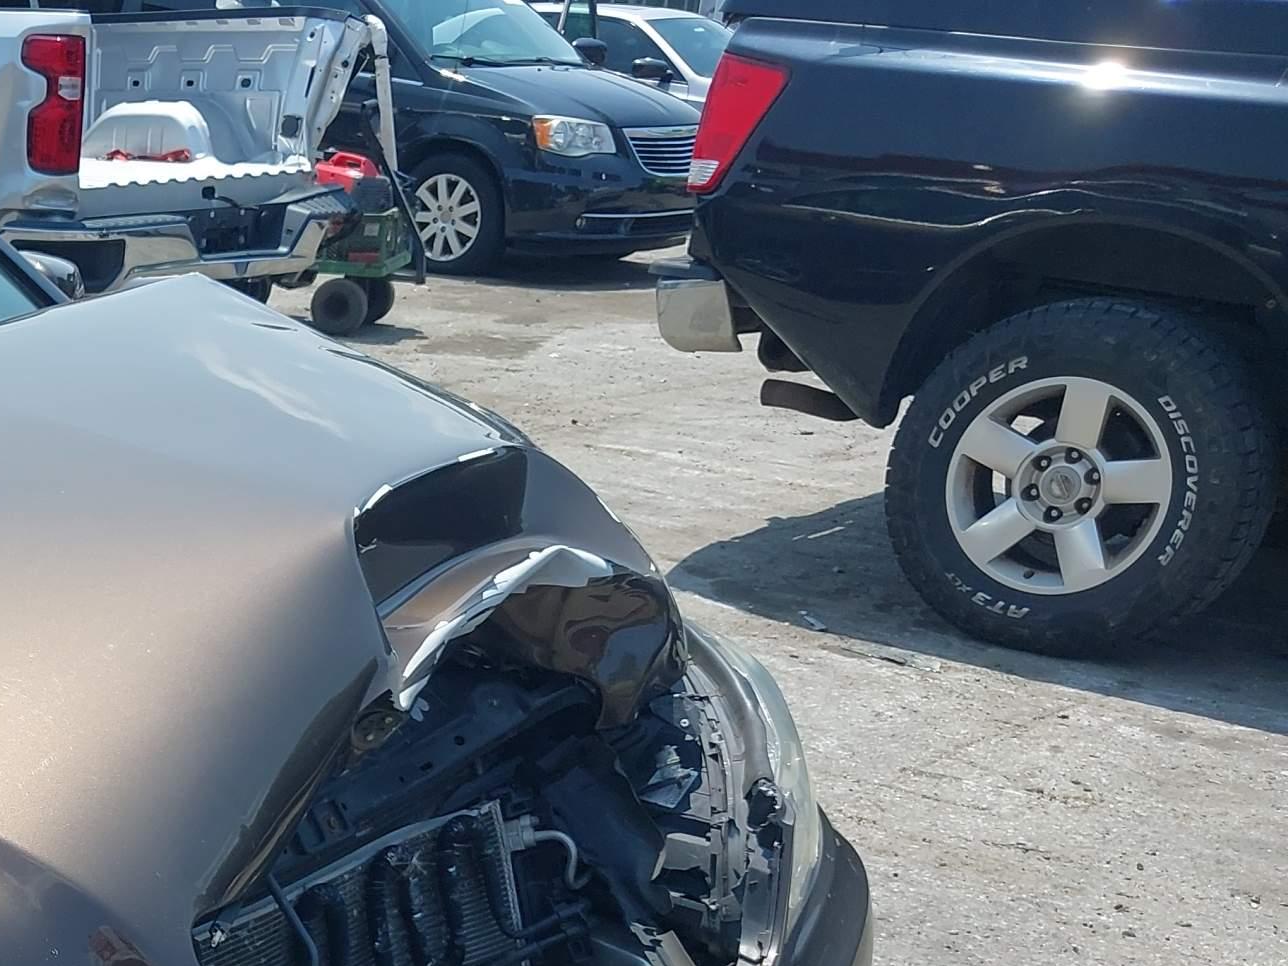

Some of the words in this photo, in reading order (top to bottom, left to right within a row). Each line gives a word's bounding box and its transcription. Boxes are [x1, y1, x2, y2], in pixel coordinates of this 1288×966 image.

[928, 356, 1028, 448] COOPER
[1157, 395, 1200, 566] DISCOVERER
[971, 592, 1031, 618] AT3
